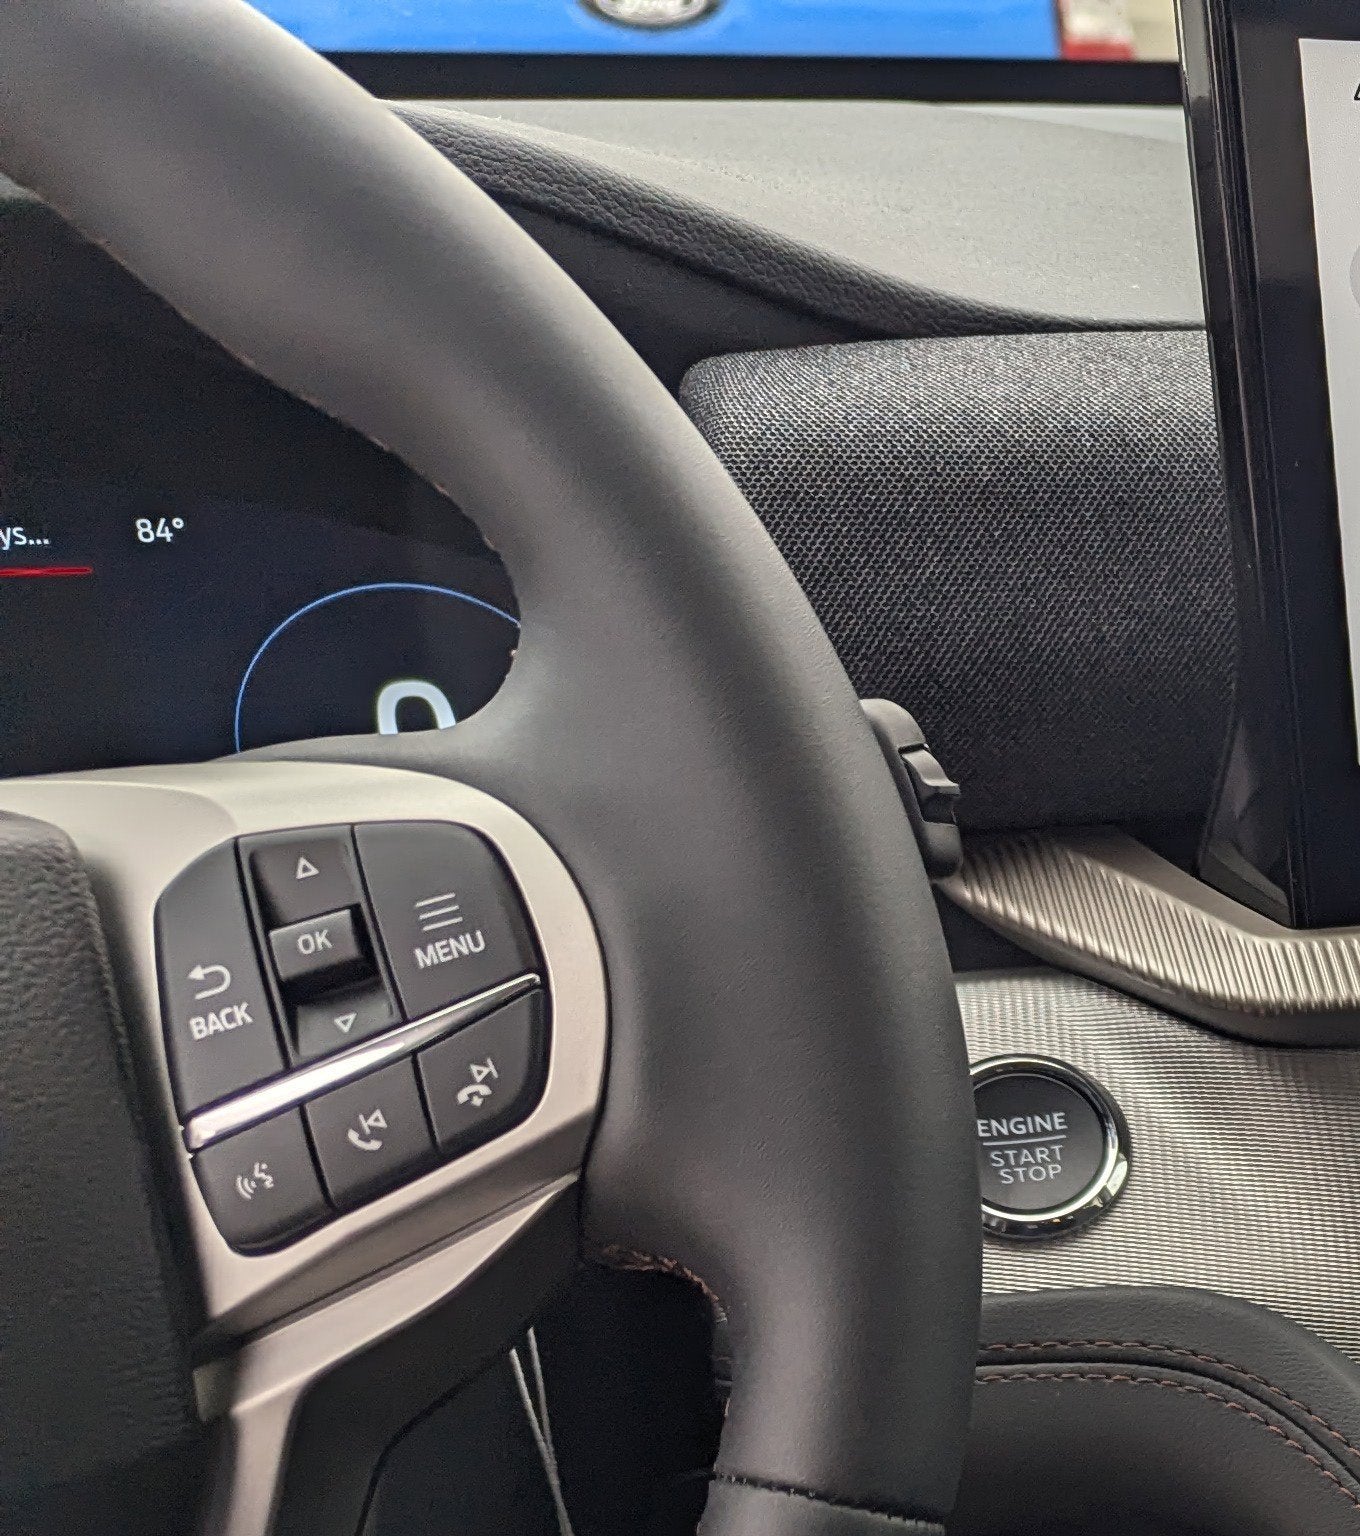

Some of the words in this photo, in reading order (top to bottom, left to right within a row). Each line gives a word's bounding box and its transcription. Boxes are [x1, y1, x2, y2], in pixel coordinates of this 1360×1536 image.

[297, 929, 333, 956] OK
[415, 929, 487, 970] MENU
[189, 1002, 254, 1042] BACK
[976, 1111, 1069, 1138] ENGINE
[989, 1144, 1064, 1168] START
[998, 1163, 1062, 1185] STOP
